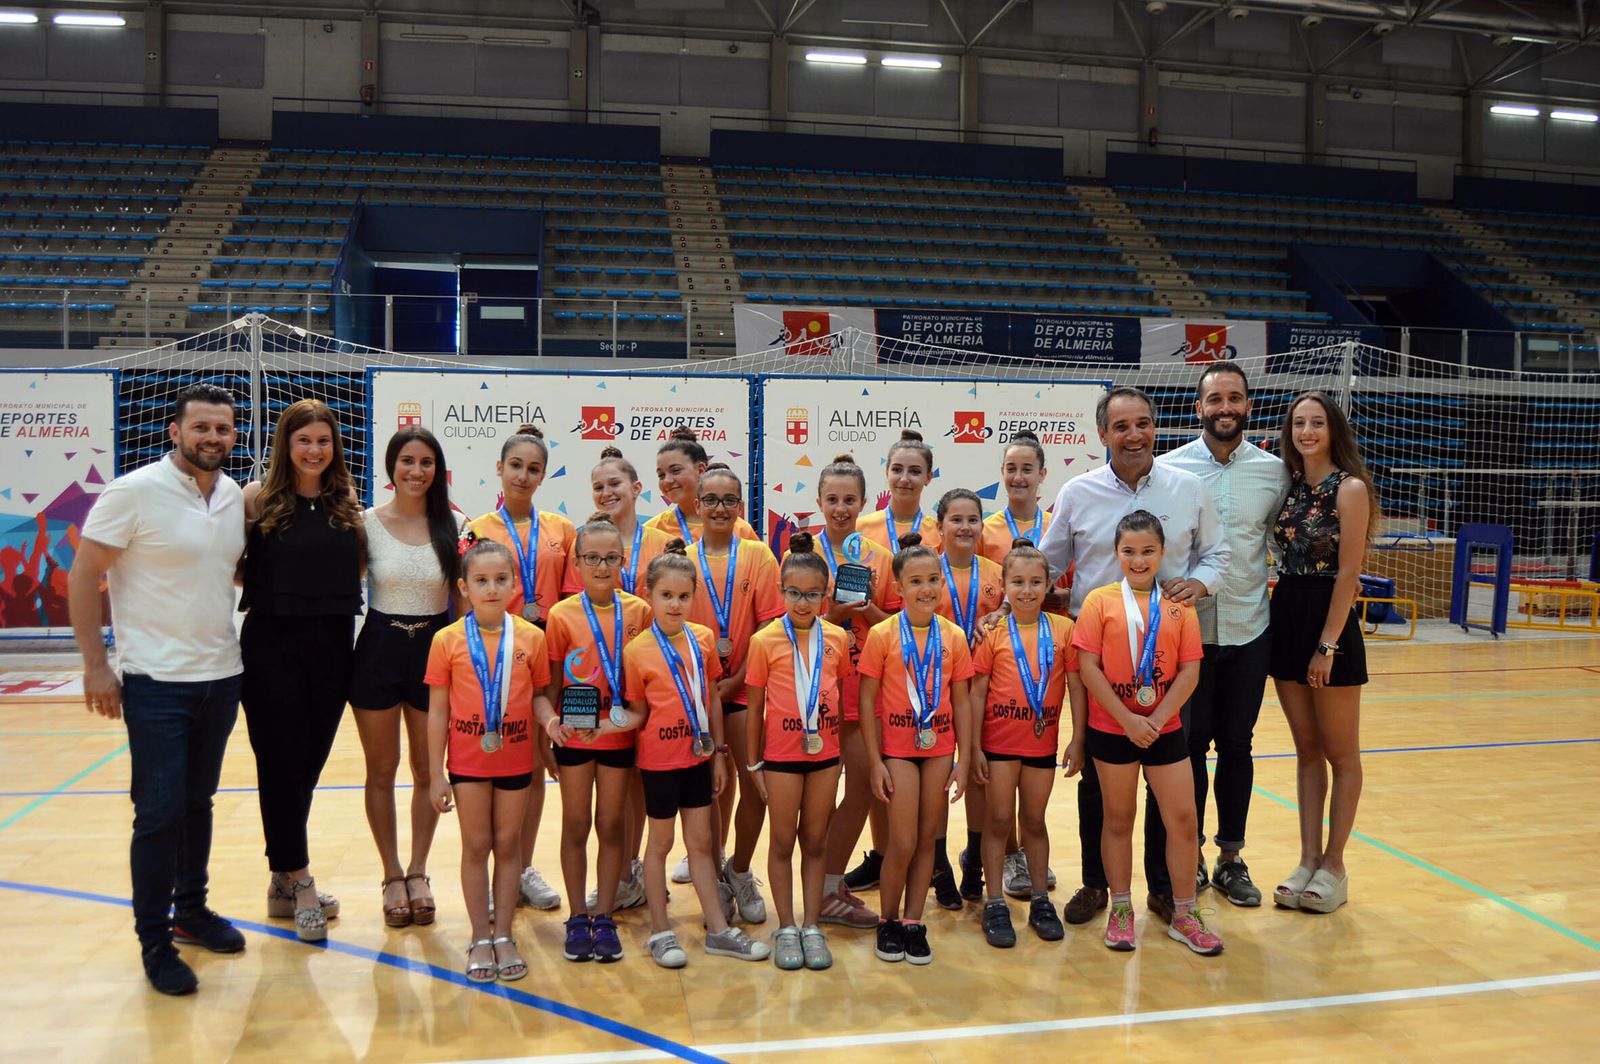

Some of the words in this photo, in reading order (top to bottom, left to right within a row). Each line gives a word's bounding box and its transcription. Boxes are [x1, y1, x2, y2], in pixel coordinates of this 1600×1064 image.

[902, 321, 984, 333] DEPORTES
[1034, 324, 1114, 339] DEPORTES
[903, 334, 922, 344] DE
[924, 334, 984, 346] ALMERIA
[1034, 337, 1053, 349] DE
[1055, 339, 1114, 351] ALMERIA
[444, 401, 546, 423] ALMERÍA
[829, 406, 923, 428] ALMERÍA
[0, 413, 78, 425] EPORTES
[630, 416, 716, 428] DEPORTES
[0, 426, 11, 438] E
[16, 426, 90, 438] ALMERIA
[443, 426, 497, 438] CIUDAD
[998, 420, 1076, 433] DEPORTES
[630, 429, 652, 441] DE
[828, 430, 877, 442] CIUDAD
[563, 697, 598, 705] ANDALUZA
[562, 705, 598, 714] GIMNASIA
